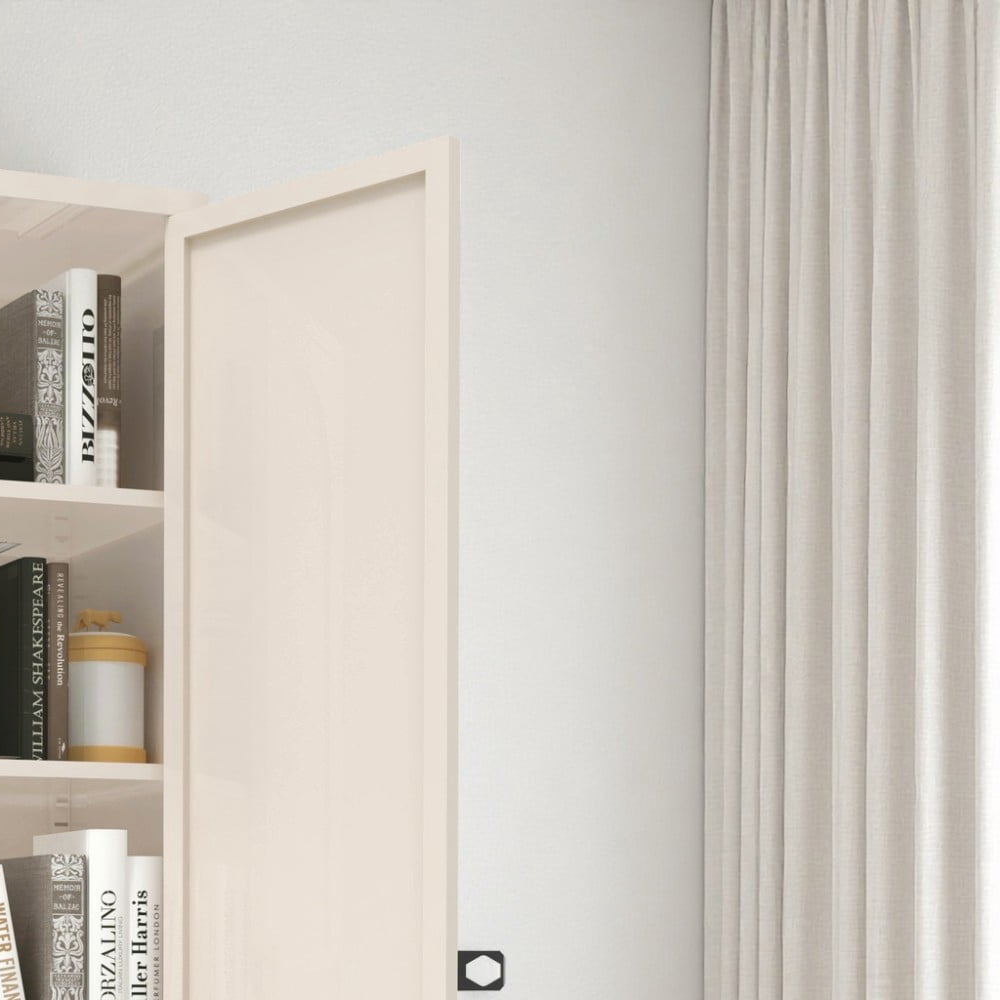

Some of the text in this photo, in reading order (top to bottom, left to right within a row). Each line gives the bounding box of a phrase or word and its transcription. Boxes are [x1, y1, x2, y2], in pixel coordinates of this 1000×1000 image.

[57, 572, 65, 618] REVEALING
[32, 562, 44, 685] SHAKESPEARE
[57, 634, 65, 686] Revolution
[53, 884, 81, 892] MEMOIR
[53, 903, 80, 911] BALZAC
[131, 889, 148, 955] Harris
